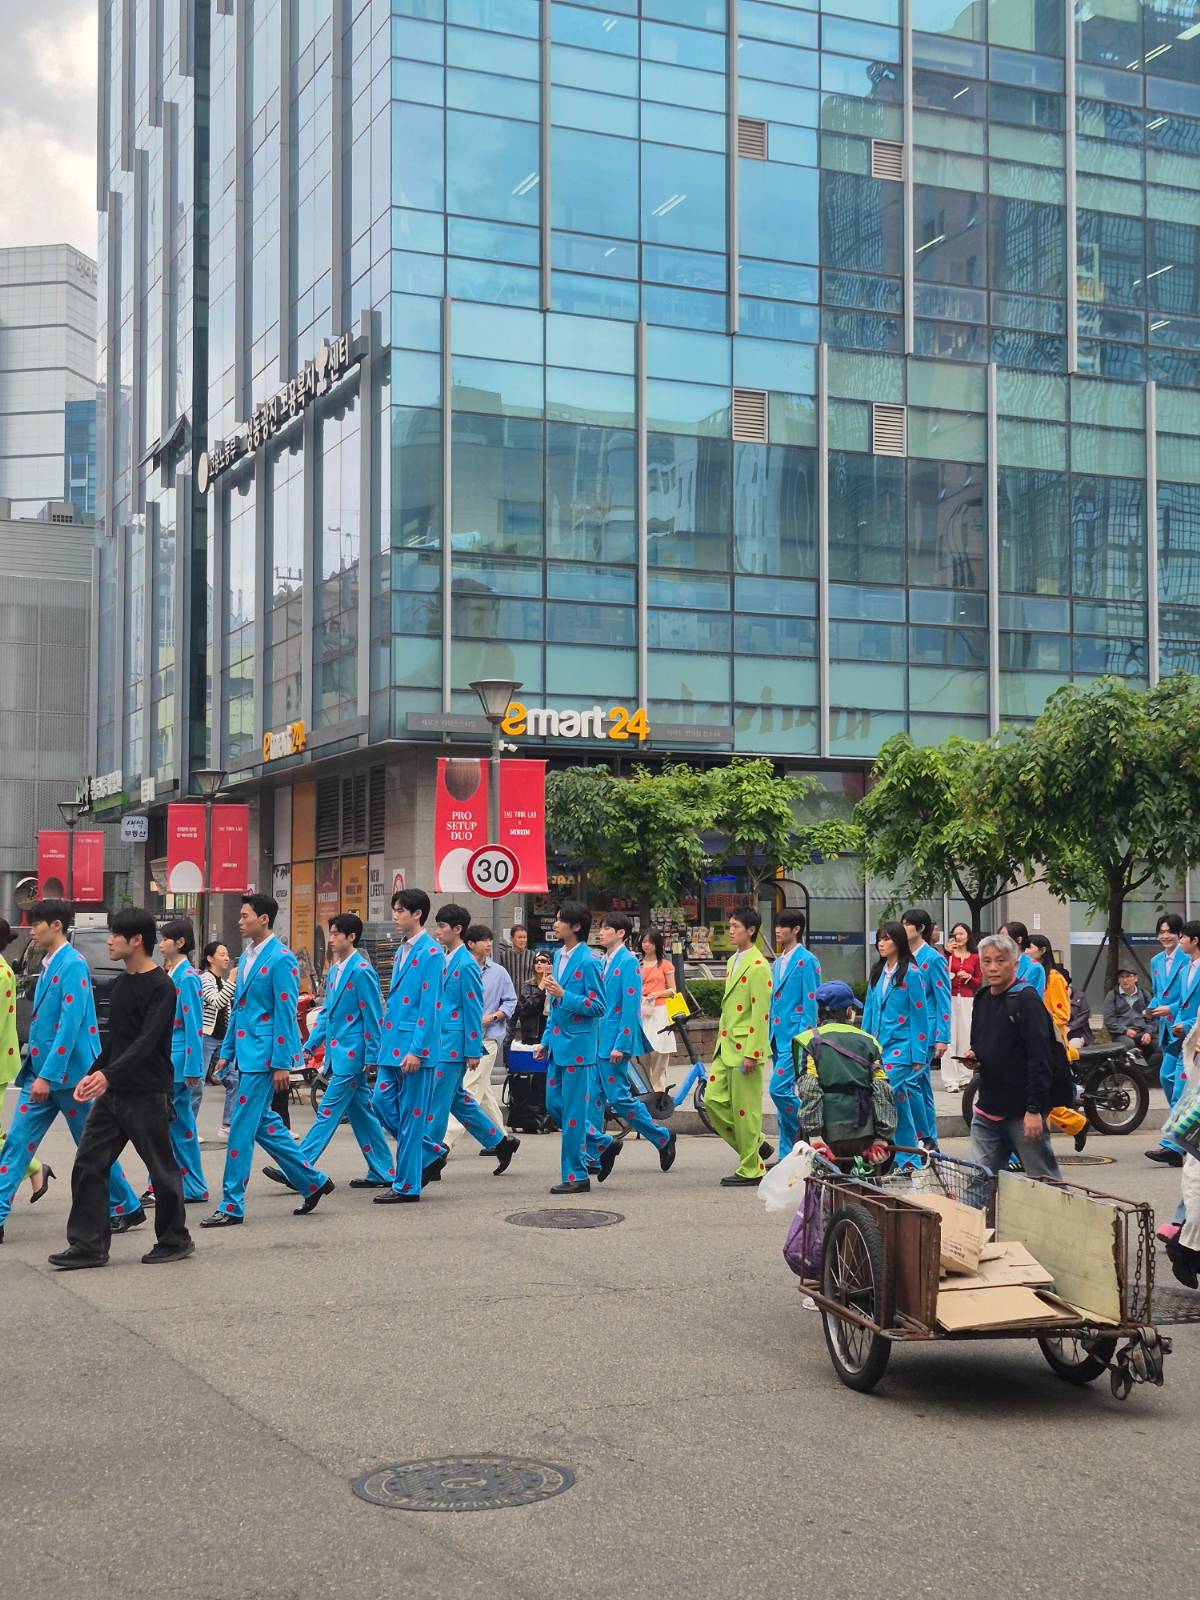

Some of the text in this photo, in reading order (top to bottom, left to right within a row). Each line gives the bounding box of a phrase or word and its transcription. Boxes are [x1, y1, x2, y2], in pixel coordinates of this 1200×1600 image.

[208, 334, 349, 476] 고용노동부 성동광진 고용복지 센터
[501, 702, 650, 741] emart24
[451, 811, 472, 821] PRO
[446, 821, 477, 831] SETUP
[450, 831, 473, 841] DUO
[370, 869, 380, 883] NEW
[477, 859, 509, 884] 30
